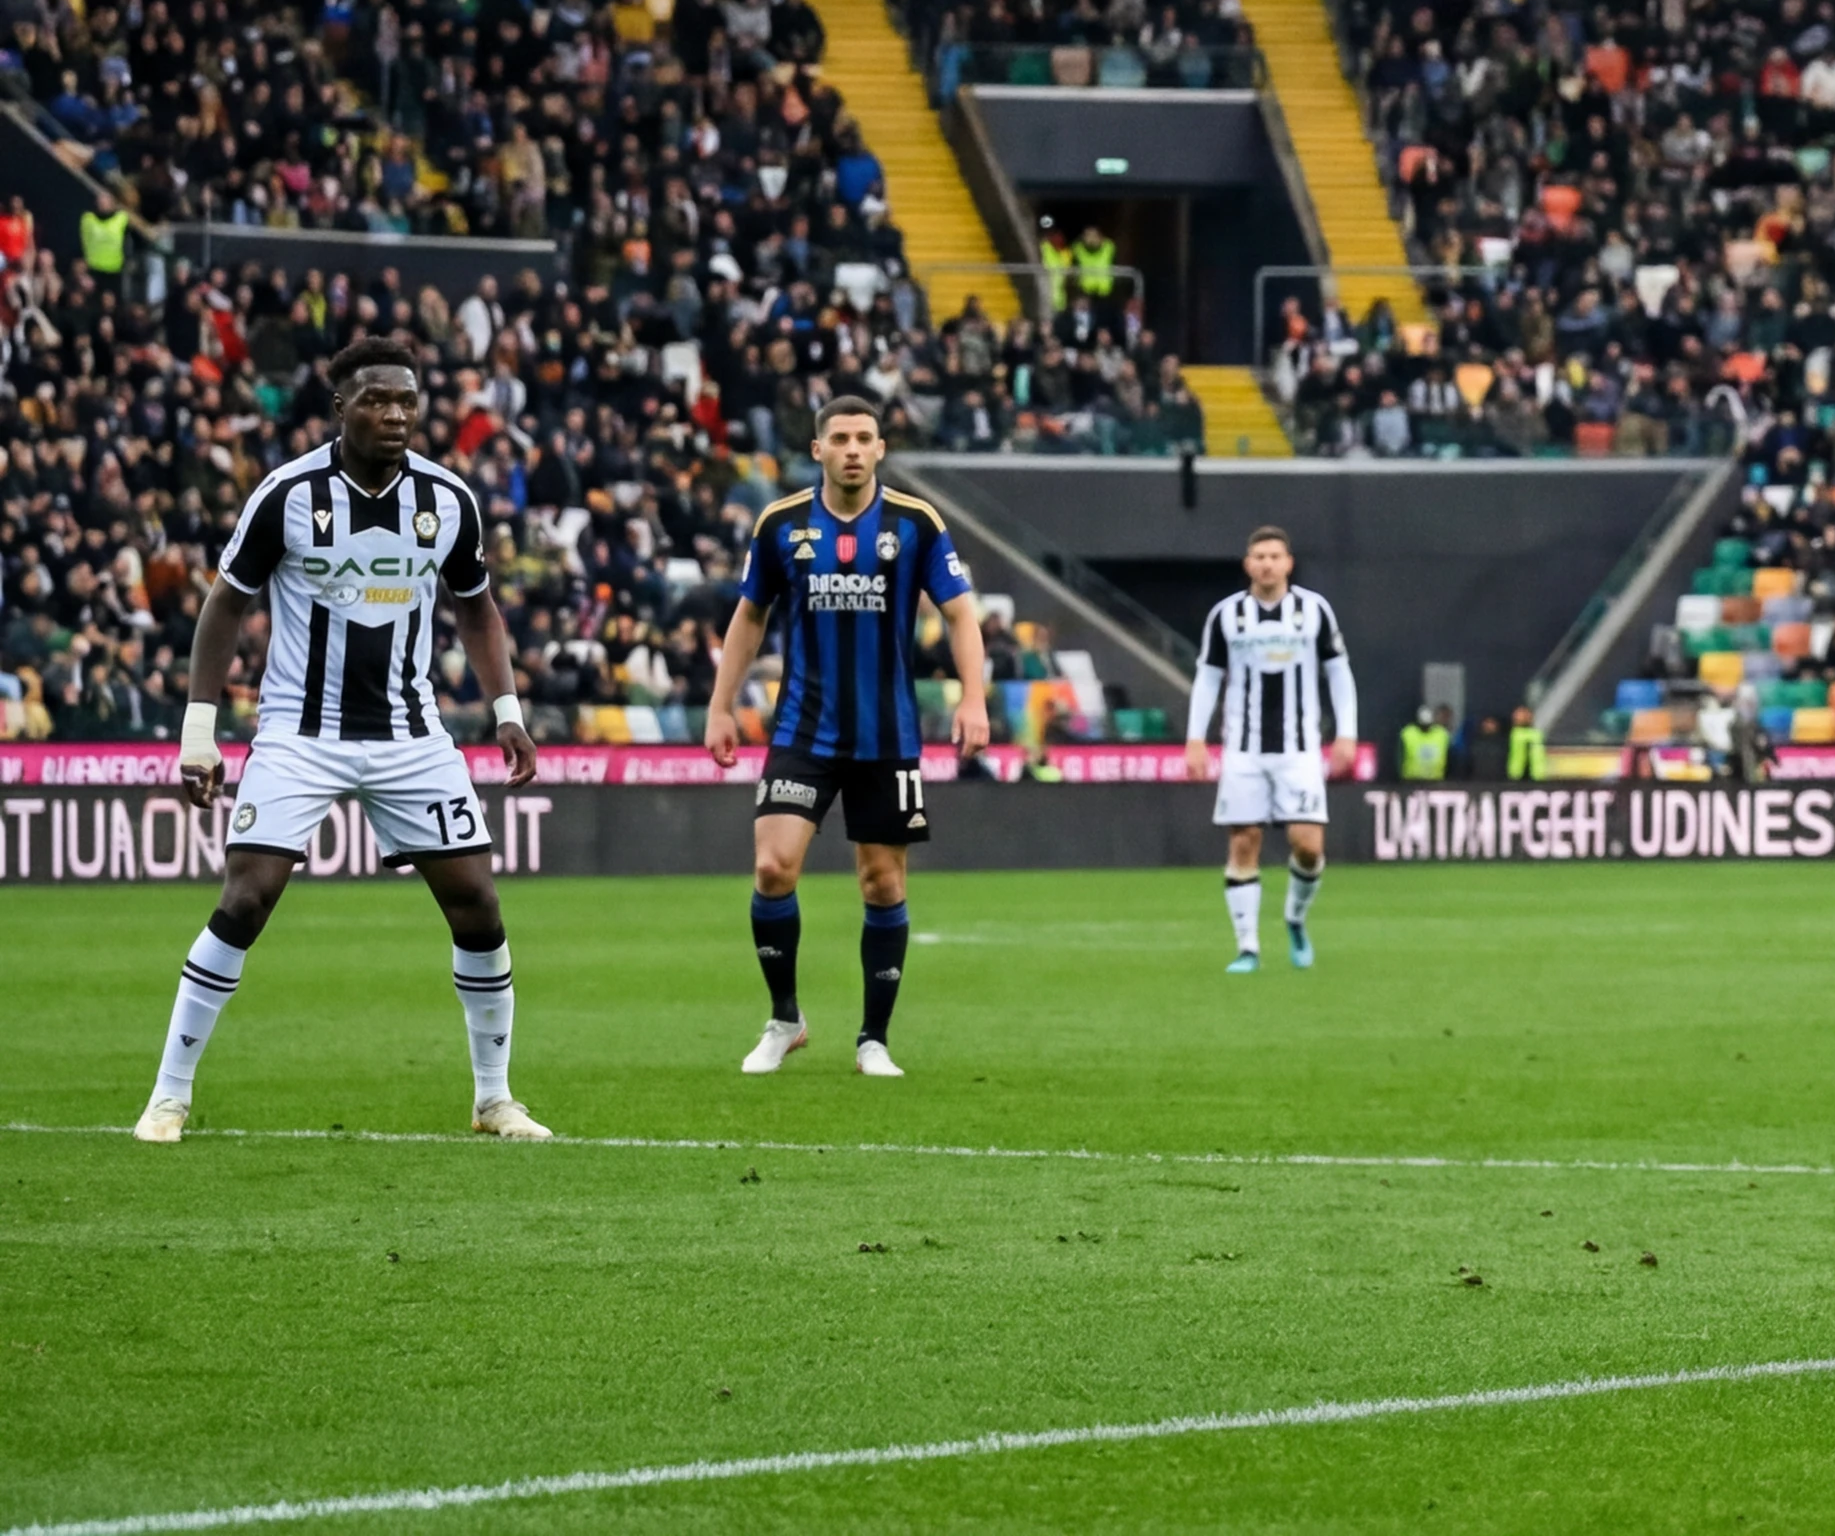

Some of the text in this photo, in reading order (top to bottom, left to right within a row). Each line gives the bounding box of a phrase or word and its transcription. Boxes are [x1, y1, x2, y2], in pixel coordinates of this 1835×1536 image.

[302, 557, 437, 577] DACIA
[895, 769, 924, 811] 11
[427, 796, 477, 845] 13
